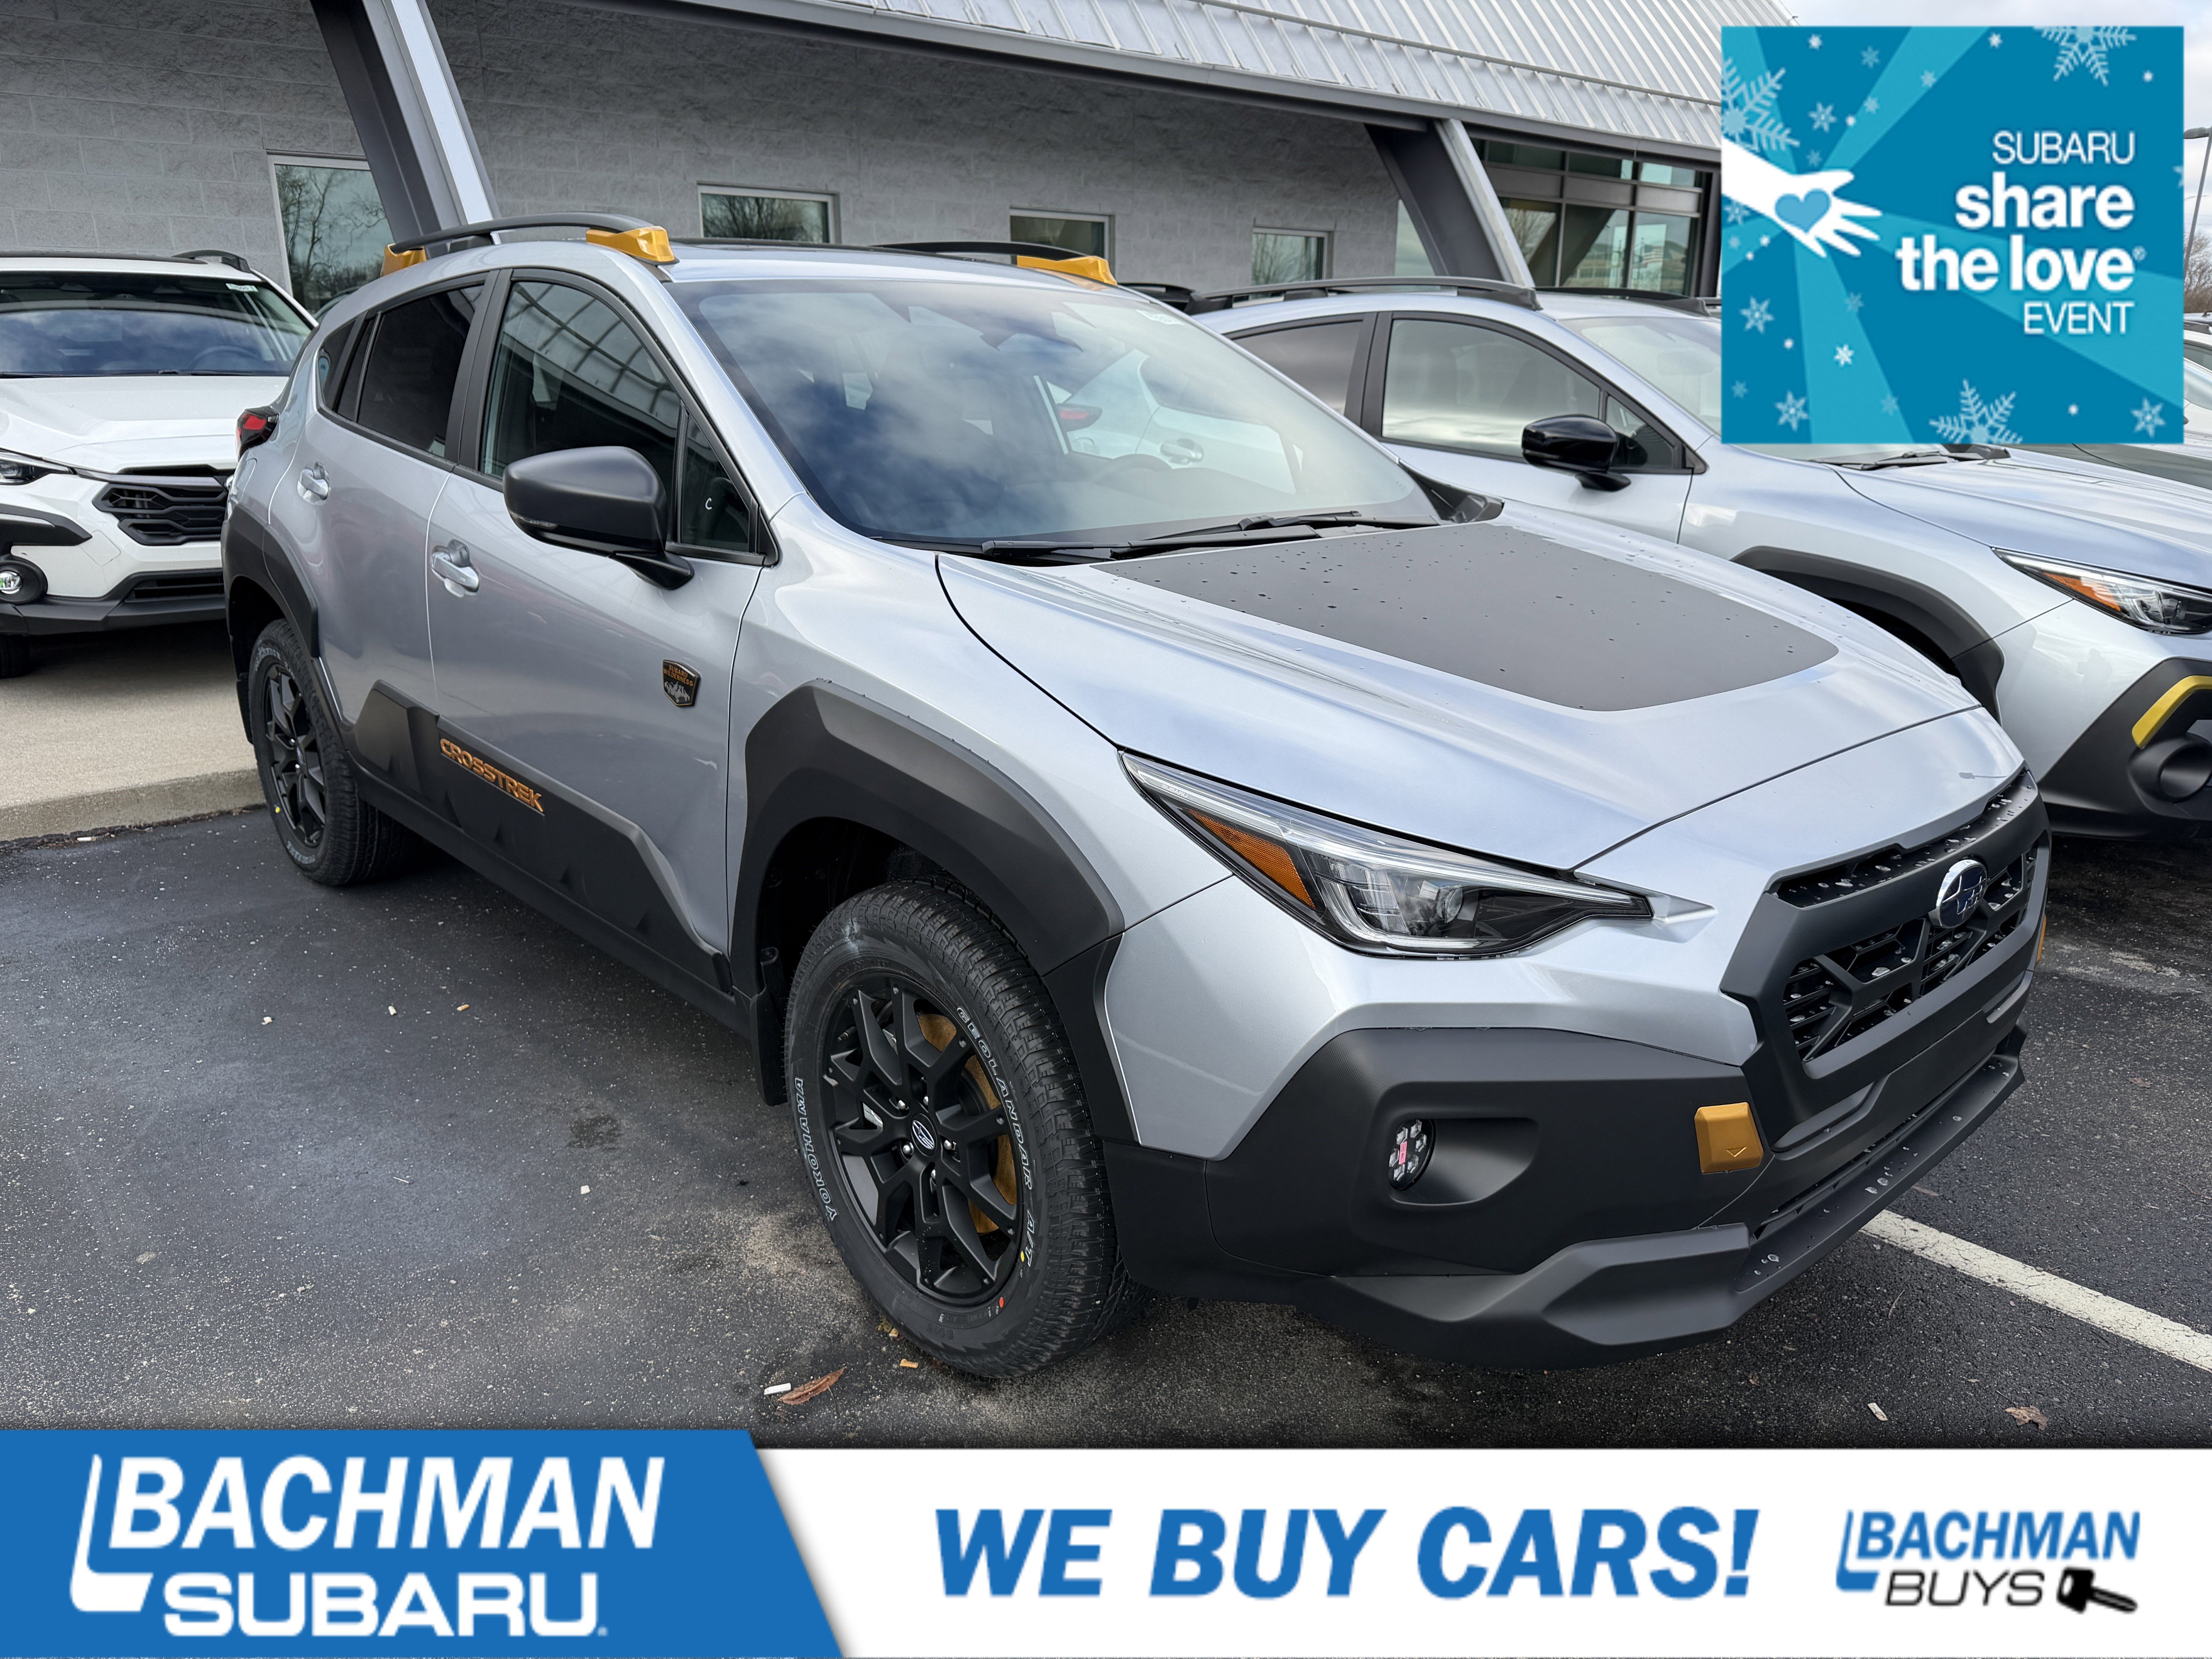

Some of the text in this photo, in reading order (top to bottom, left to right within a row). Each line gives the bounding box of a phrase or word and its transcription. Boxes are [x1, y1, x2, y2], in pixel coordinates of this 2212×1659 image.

[663, 668, 694, 687] WILDERNESS
[669, 665, 688, 678] SUBARU
[440, 738, 543, 812] CROSSTREK
[1161, 784, 1188, 798] SUBARU
[956, 1007, 1032, 1190] GEOLANDAR
[795, 1077, 837, 1221] YOKOHAMA
